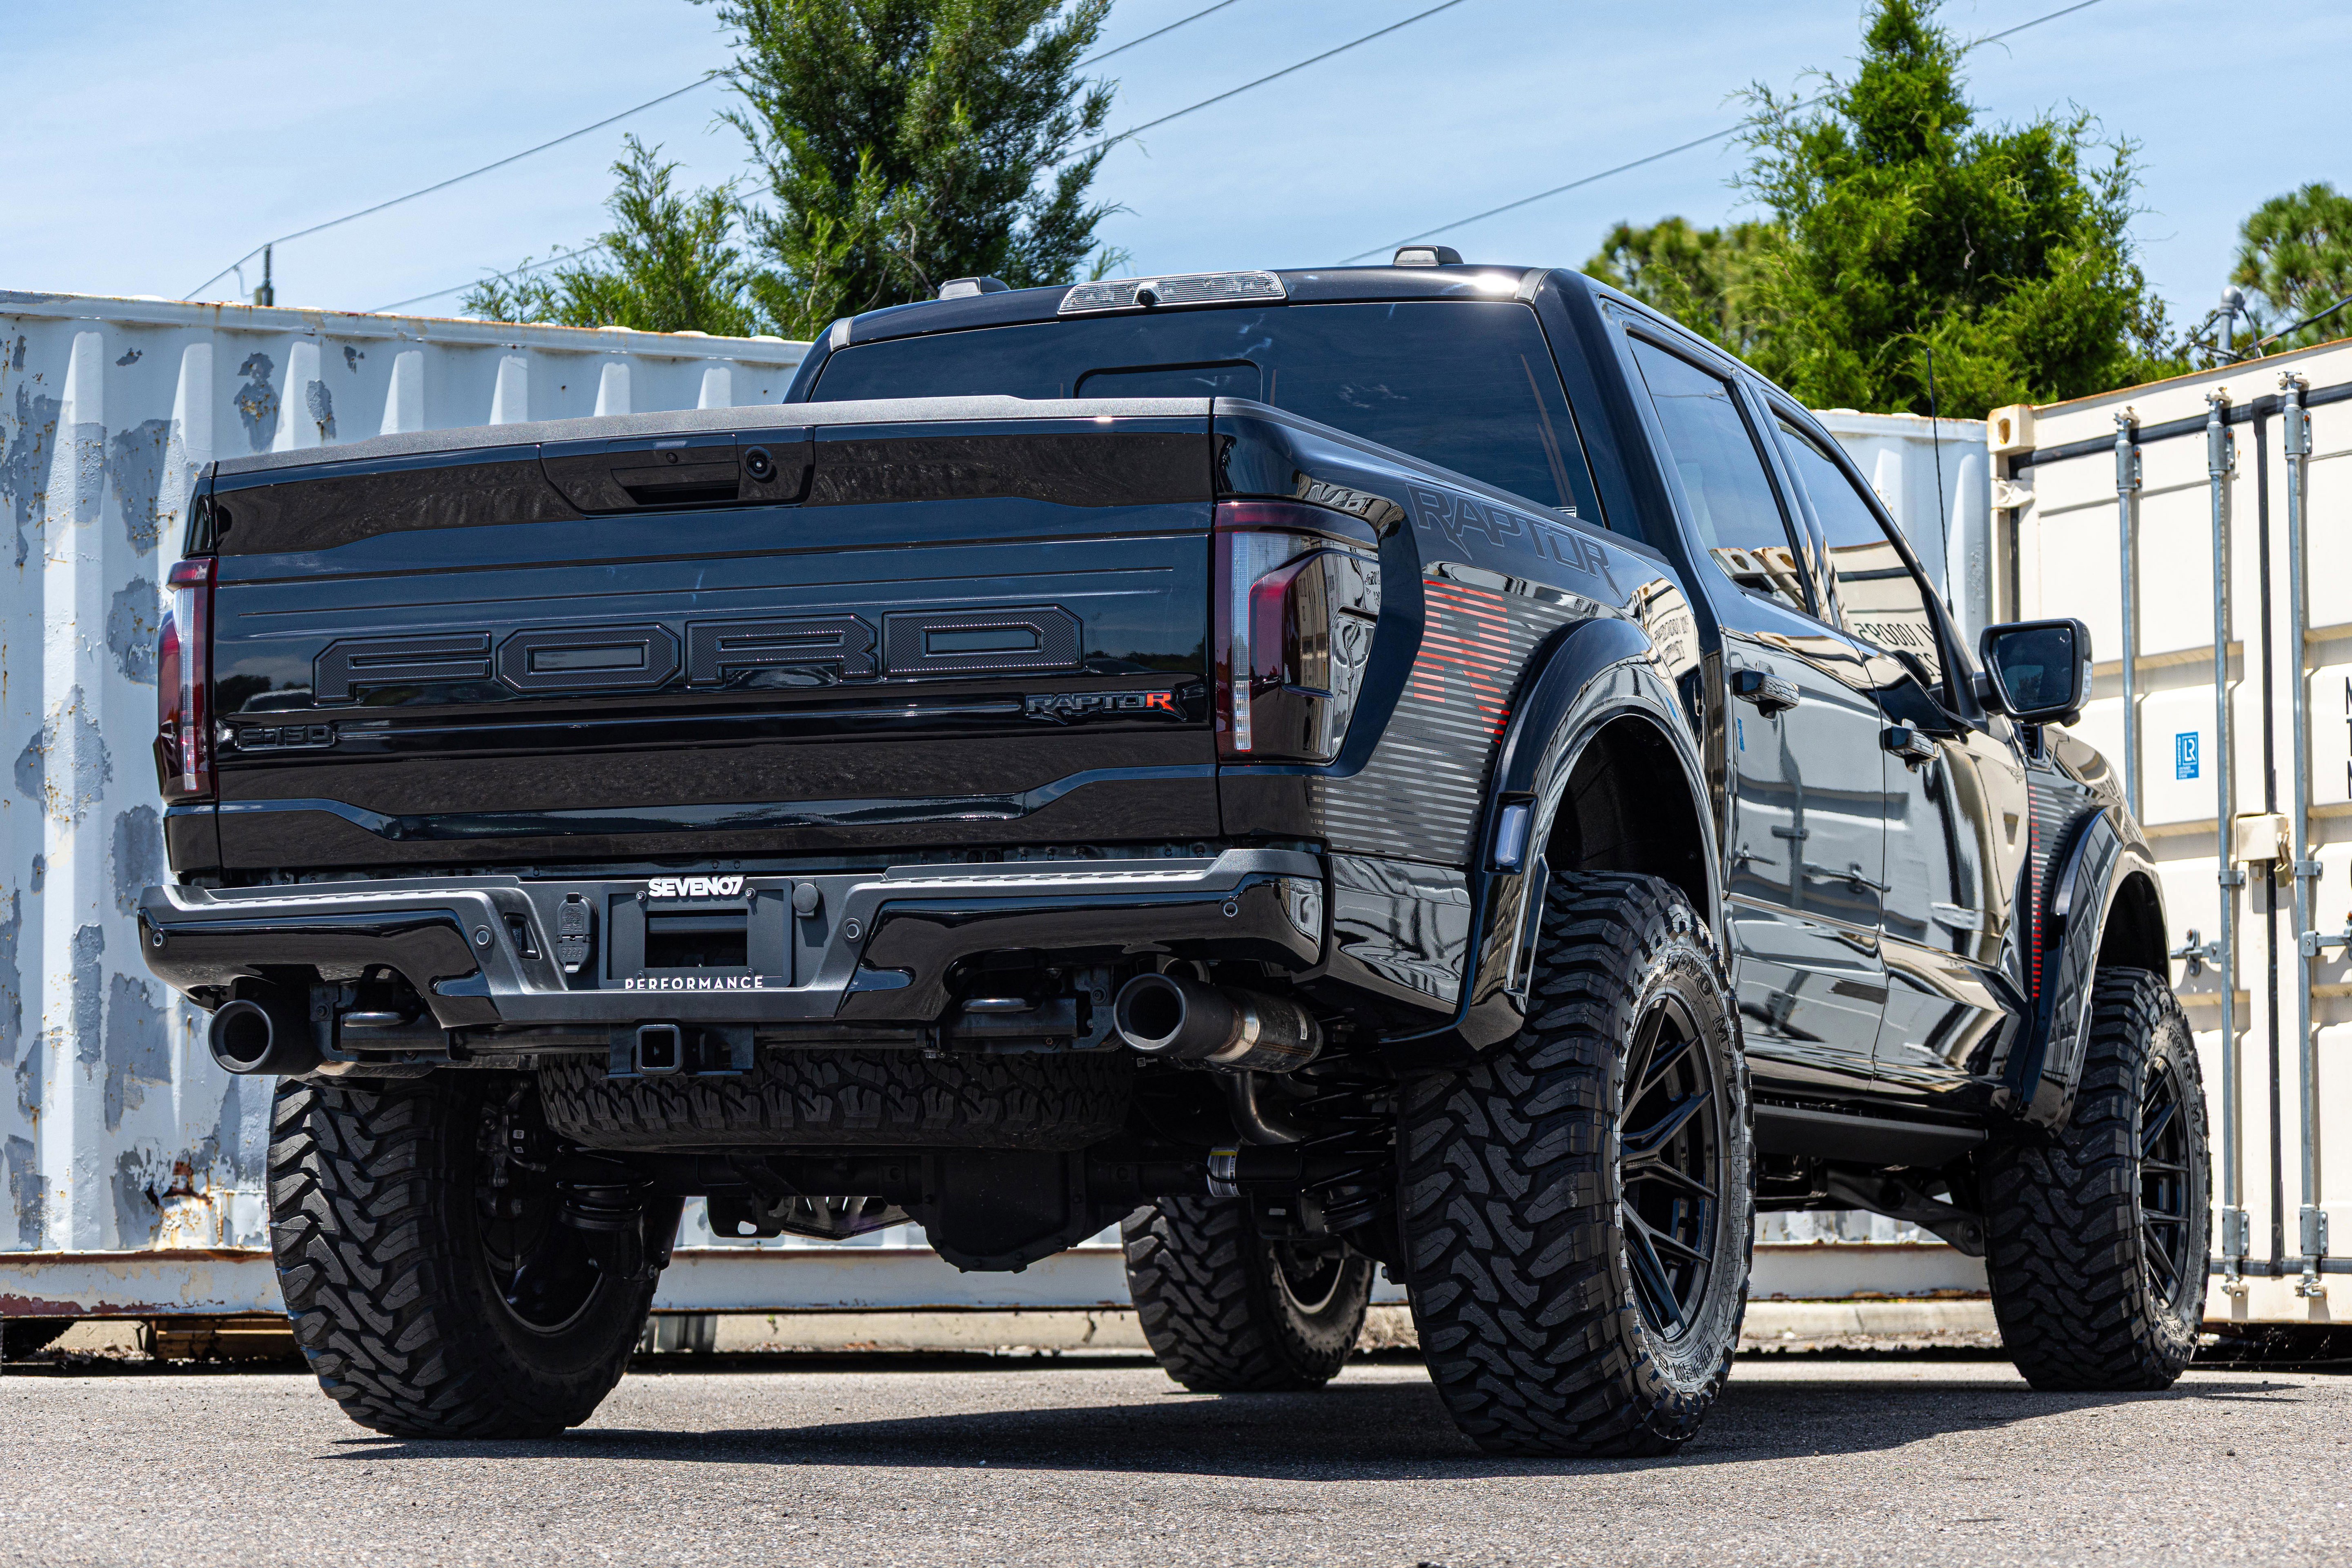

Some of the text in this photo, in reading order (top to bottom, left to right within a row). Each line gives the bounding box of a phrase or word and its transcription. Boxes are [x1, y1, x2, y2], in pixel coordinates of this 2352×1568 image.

[1405, 482, 1627, 610] RAPTOR
[313, 604, 1084, 705] FORD
[1025, 689, 1187, 725] RAPTOR
[237, 724, 333, 748] F-150
[2184, 738, 2196, 762] LR
[625, 976, 763, 989] PERFORMANCE
[1665, 951, 1714, 998] TOYO
[2167, 1026, 2193, 1081] TOYO
[1673, 1340, 1715, 1383] OPEN
